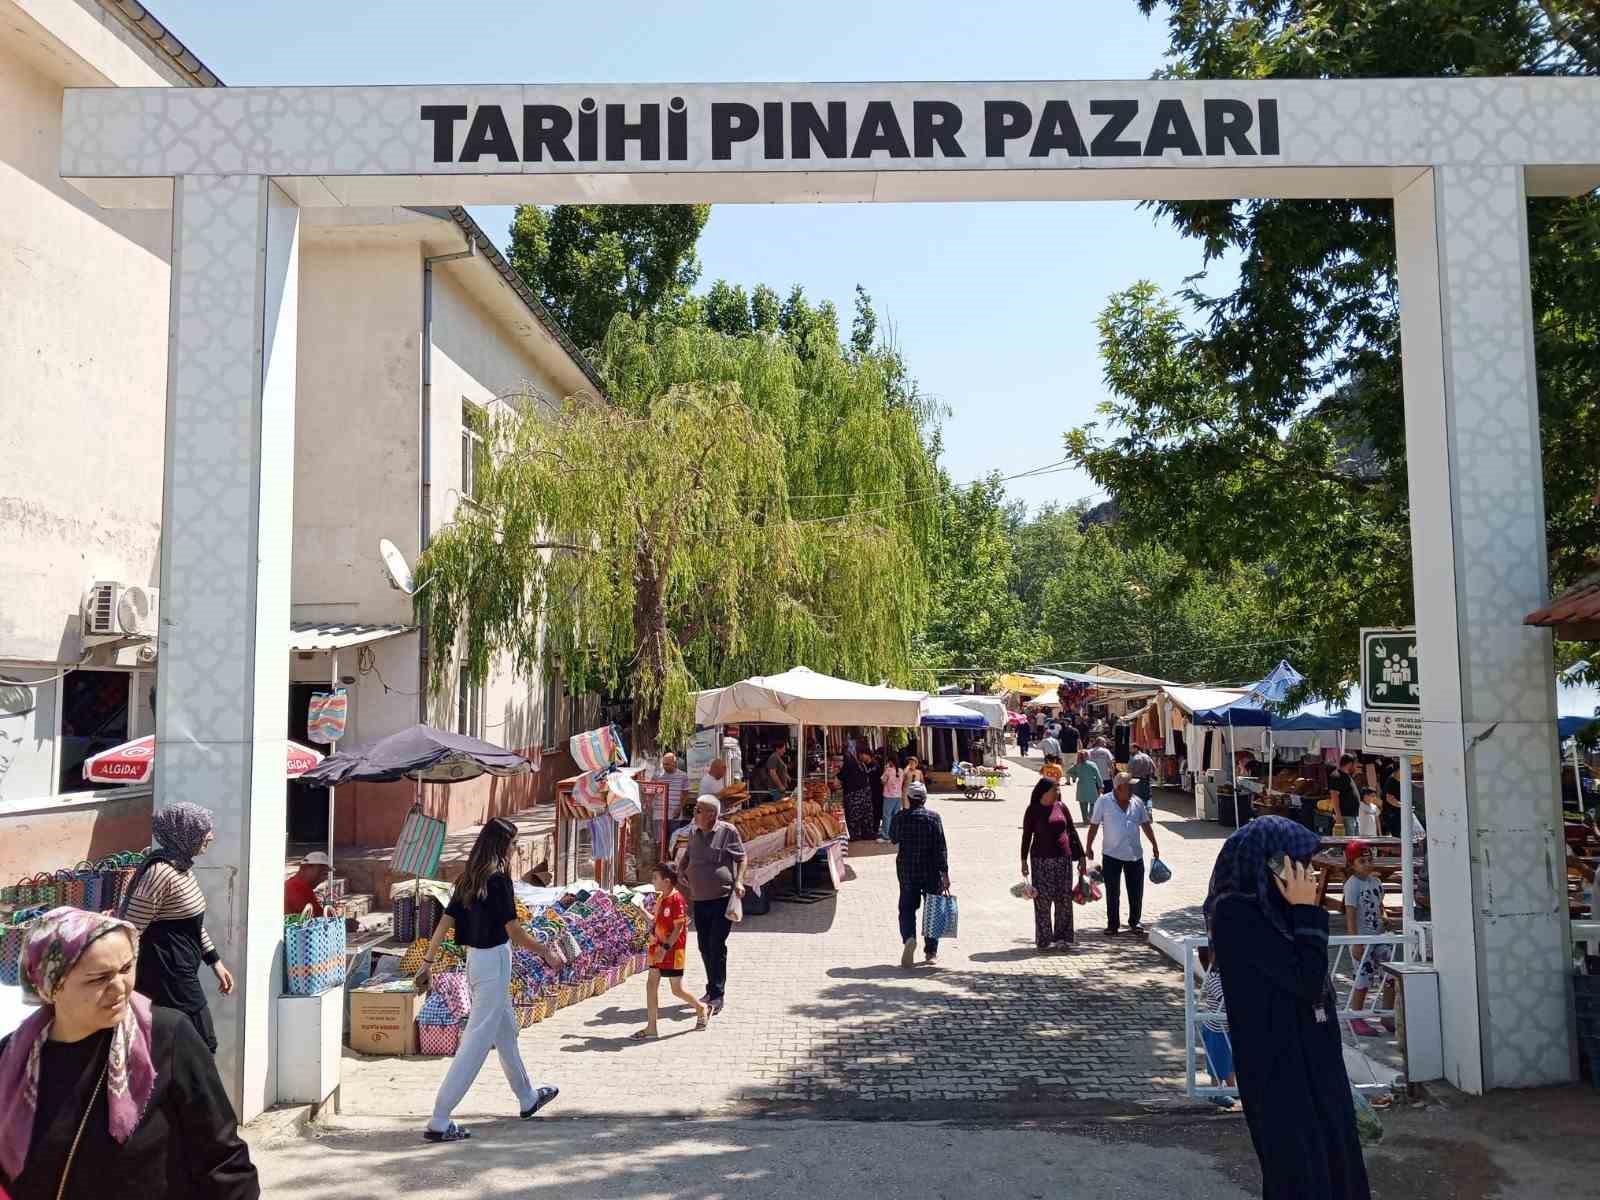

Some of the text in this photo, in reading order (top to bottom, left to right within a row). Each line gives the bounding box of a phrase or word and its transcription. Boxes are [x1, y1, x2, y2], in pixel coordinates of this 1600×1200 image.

[421, 97, 1280, 163] TARİHİ PINAR PAZARI
[287, 759, 309, 769] GİDA
